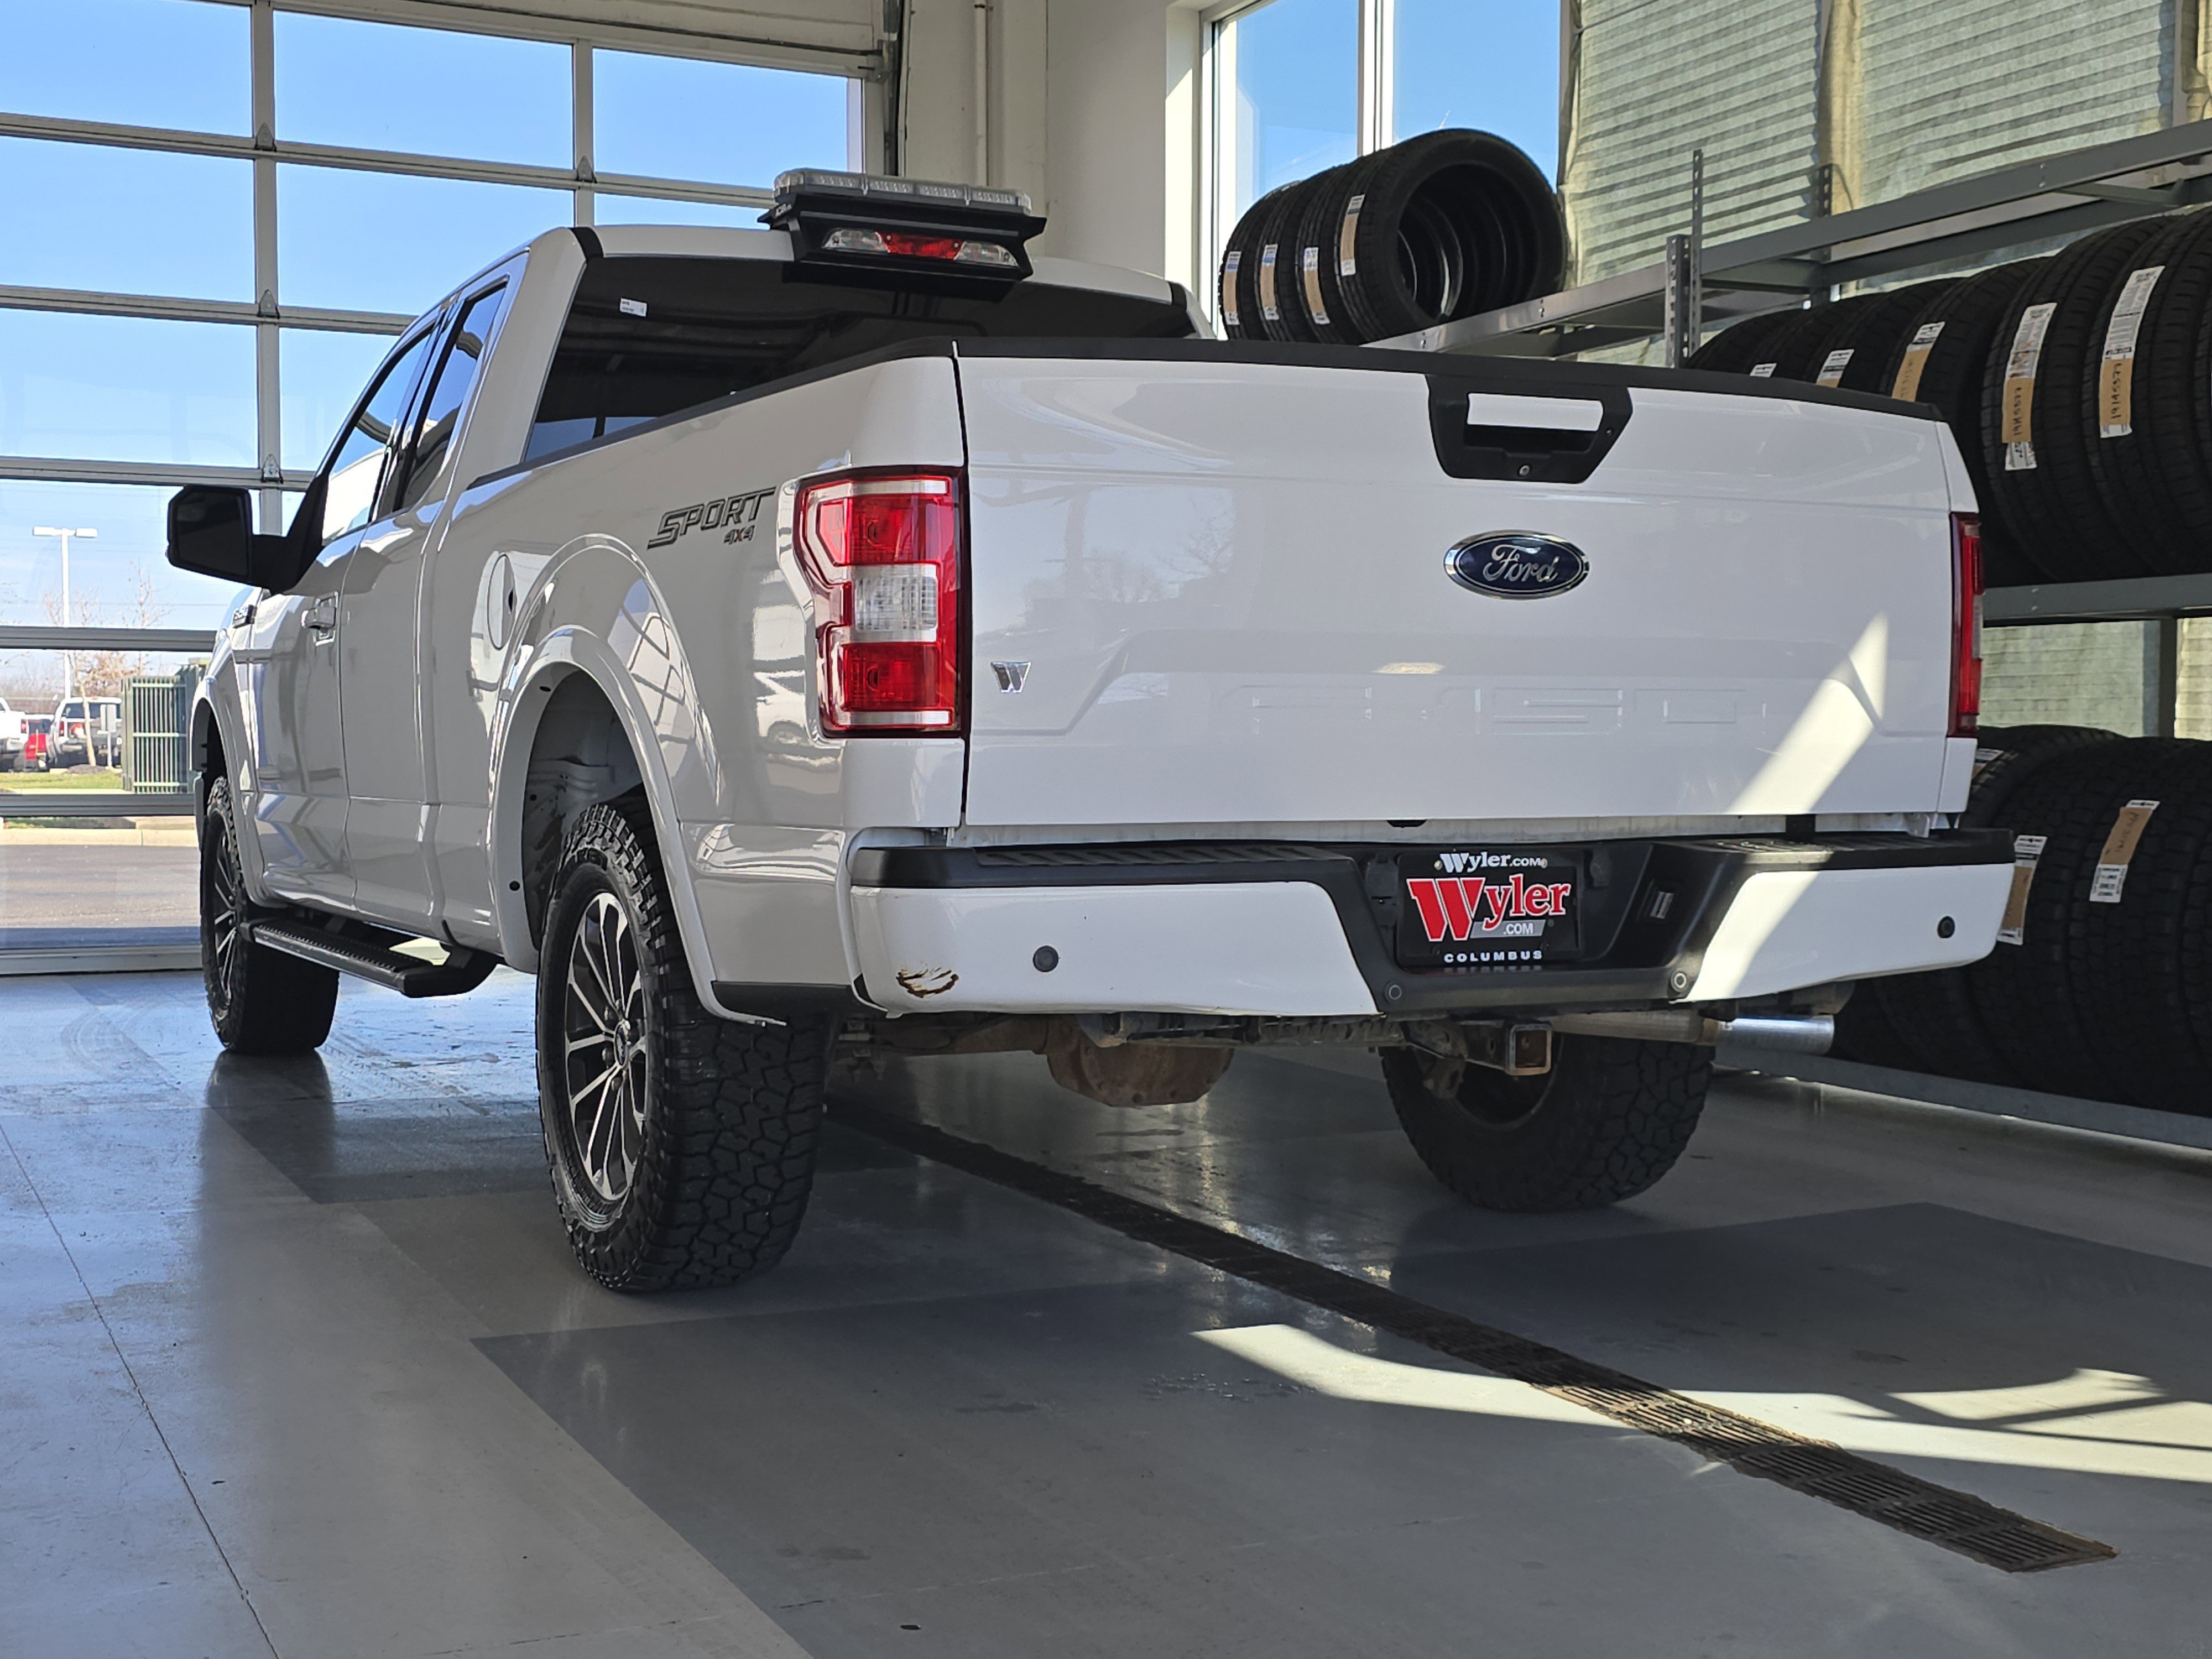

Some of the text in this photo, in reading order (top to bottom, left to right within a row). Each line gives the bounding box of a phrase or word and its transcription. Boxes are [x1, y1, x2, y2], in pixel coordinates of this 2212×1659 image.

[646, 486, 776, 550] SPORT
[1483, 544, 1559, 582] Ford
[1406, 874, 1571, 942] Wyler
[1503, 923, 1533, 935] .COM
[1444, 950, 1543, 963] COLUMBUS
